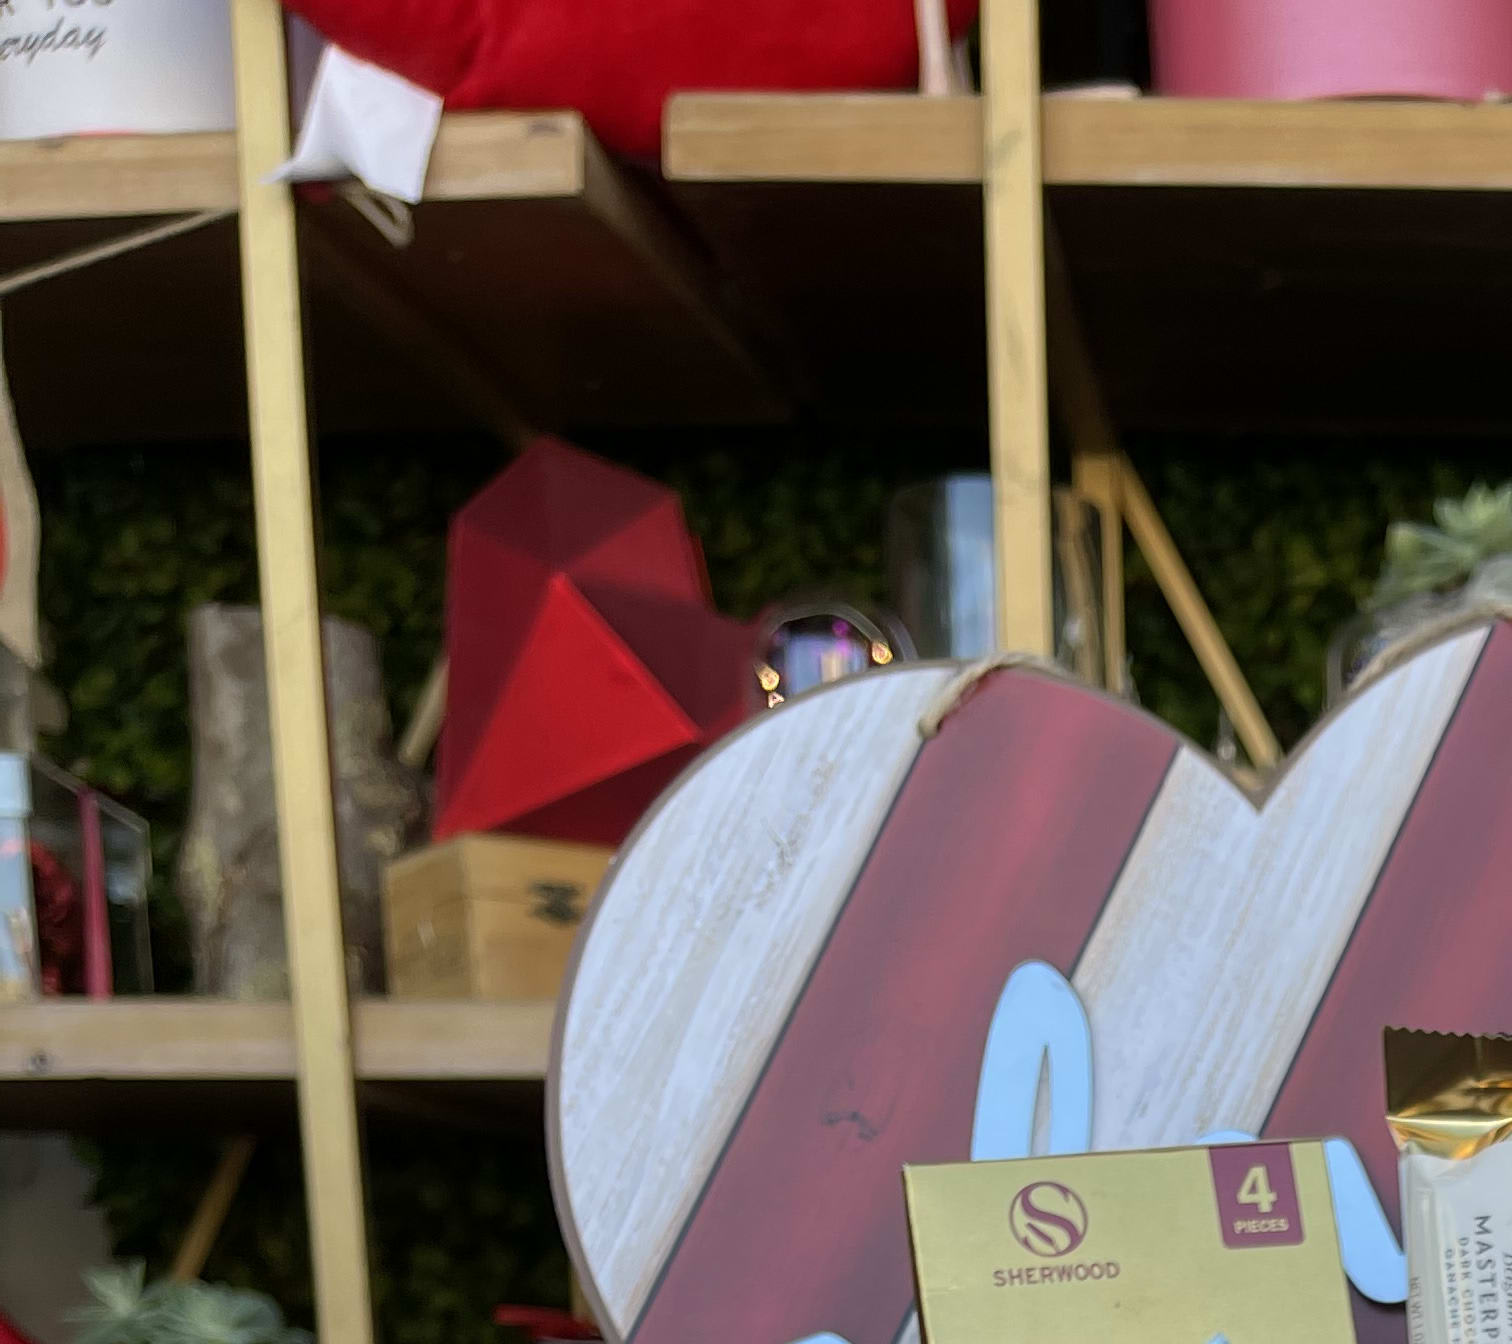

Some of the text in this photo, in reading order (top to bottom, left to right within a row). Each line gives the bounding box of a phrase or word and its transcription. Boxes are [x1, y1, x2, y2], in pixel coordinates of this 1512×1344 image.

[1237, 1164, 1278, 1214] 4
[1234, 1218, 1290, 1235] PIECES
[992, 1262, 1121, 1288] SHERWOOD
